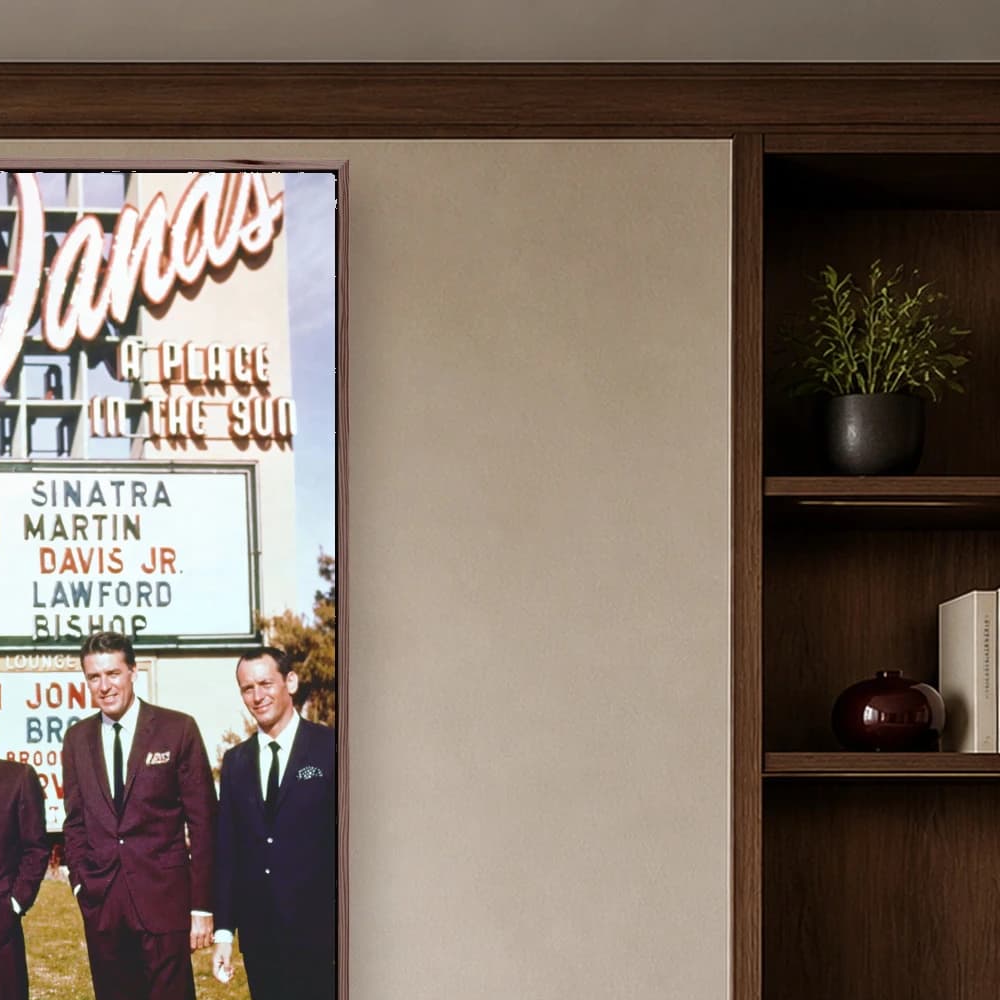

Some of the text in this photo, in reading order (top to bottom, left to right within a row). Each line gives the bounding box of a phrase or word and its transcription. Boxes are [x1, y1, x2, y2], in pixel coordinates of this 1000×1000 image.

[117, 340, 142, 382] A
[159, 340, 271, 383] PLACE
[90, 395, 127, 438] IN
[149, 396, 207, 437] THE
[229, 396, 297, 438] SUN
[31, 480, 172, 508] SINATRA
[23, 513, 141, 541] MARTIN
[39, 547, 124, 575] DAVIS
[140, 547, 183, 575] JR.
[32, 580, 172, 609] LAWFORD
[32, 614, 148, 643] BISHOP
[6, 655, 75, 669] LOUNGE
